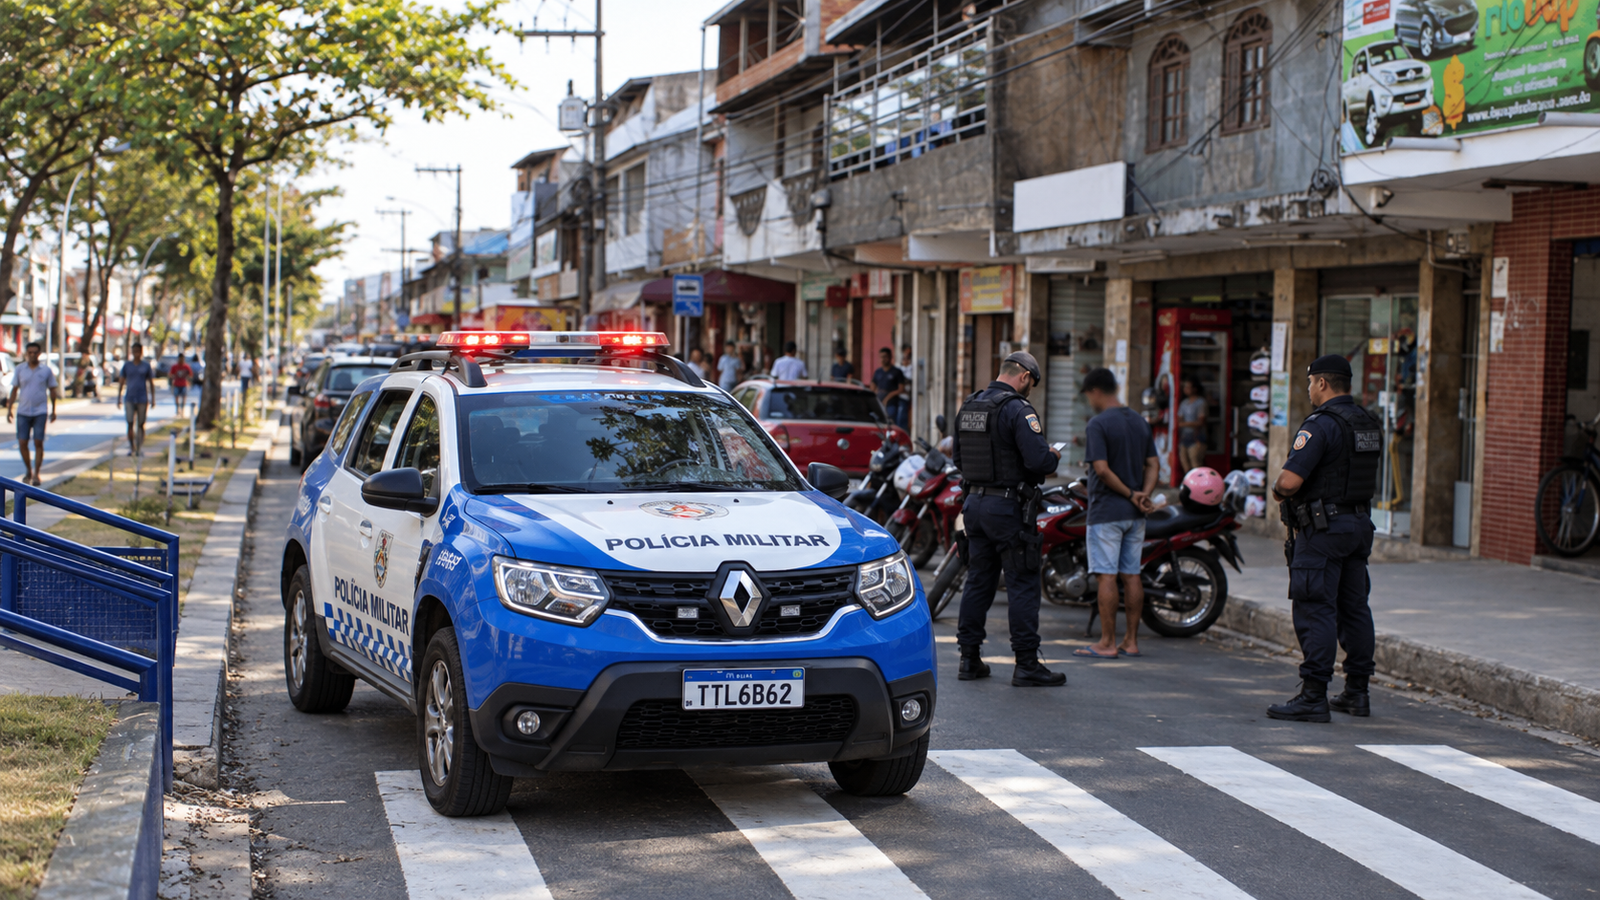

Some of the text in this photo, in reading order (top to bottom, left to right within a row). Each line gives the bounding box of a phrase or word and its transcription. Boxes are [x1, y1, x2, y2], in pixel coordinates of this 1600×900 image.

[605, 533, 830, 551] POLÍCIA MILITAR
[370, 592, 410, 637] MILITAR
[698, 683, 792, 706] TTL6B62
